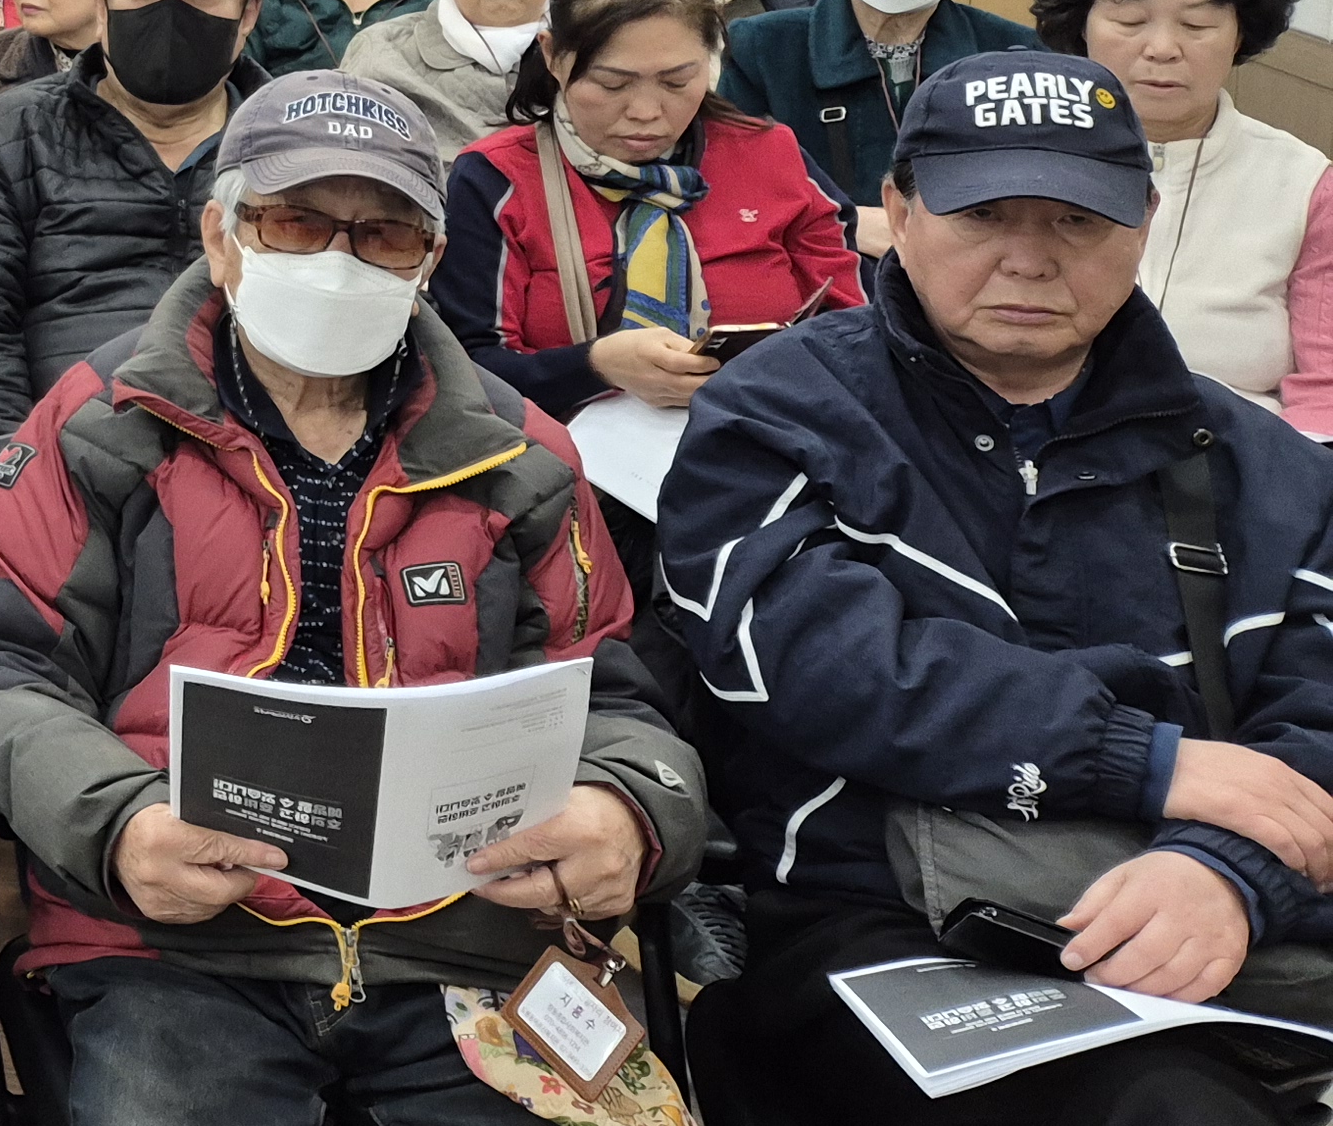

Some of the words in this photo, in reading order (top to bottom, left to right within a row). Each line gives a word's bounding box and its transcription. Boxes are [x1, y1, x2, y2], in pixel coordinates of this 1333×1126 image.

[965, 72, 1094, 107] PEARLY
[283, 91, 412, 141] HOTCHKISS
[975, 97, 1094, 129] GATES
[327, 121, 373, 139] DAD
